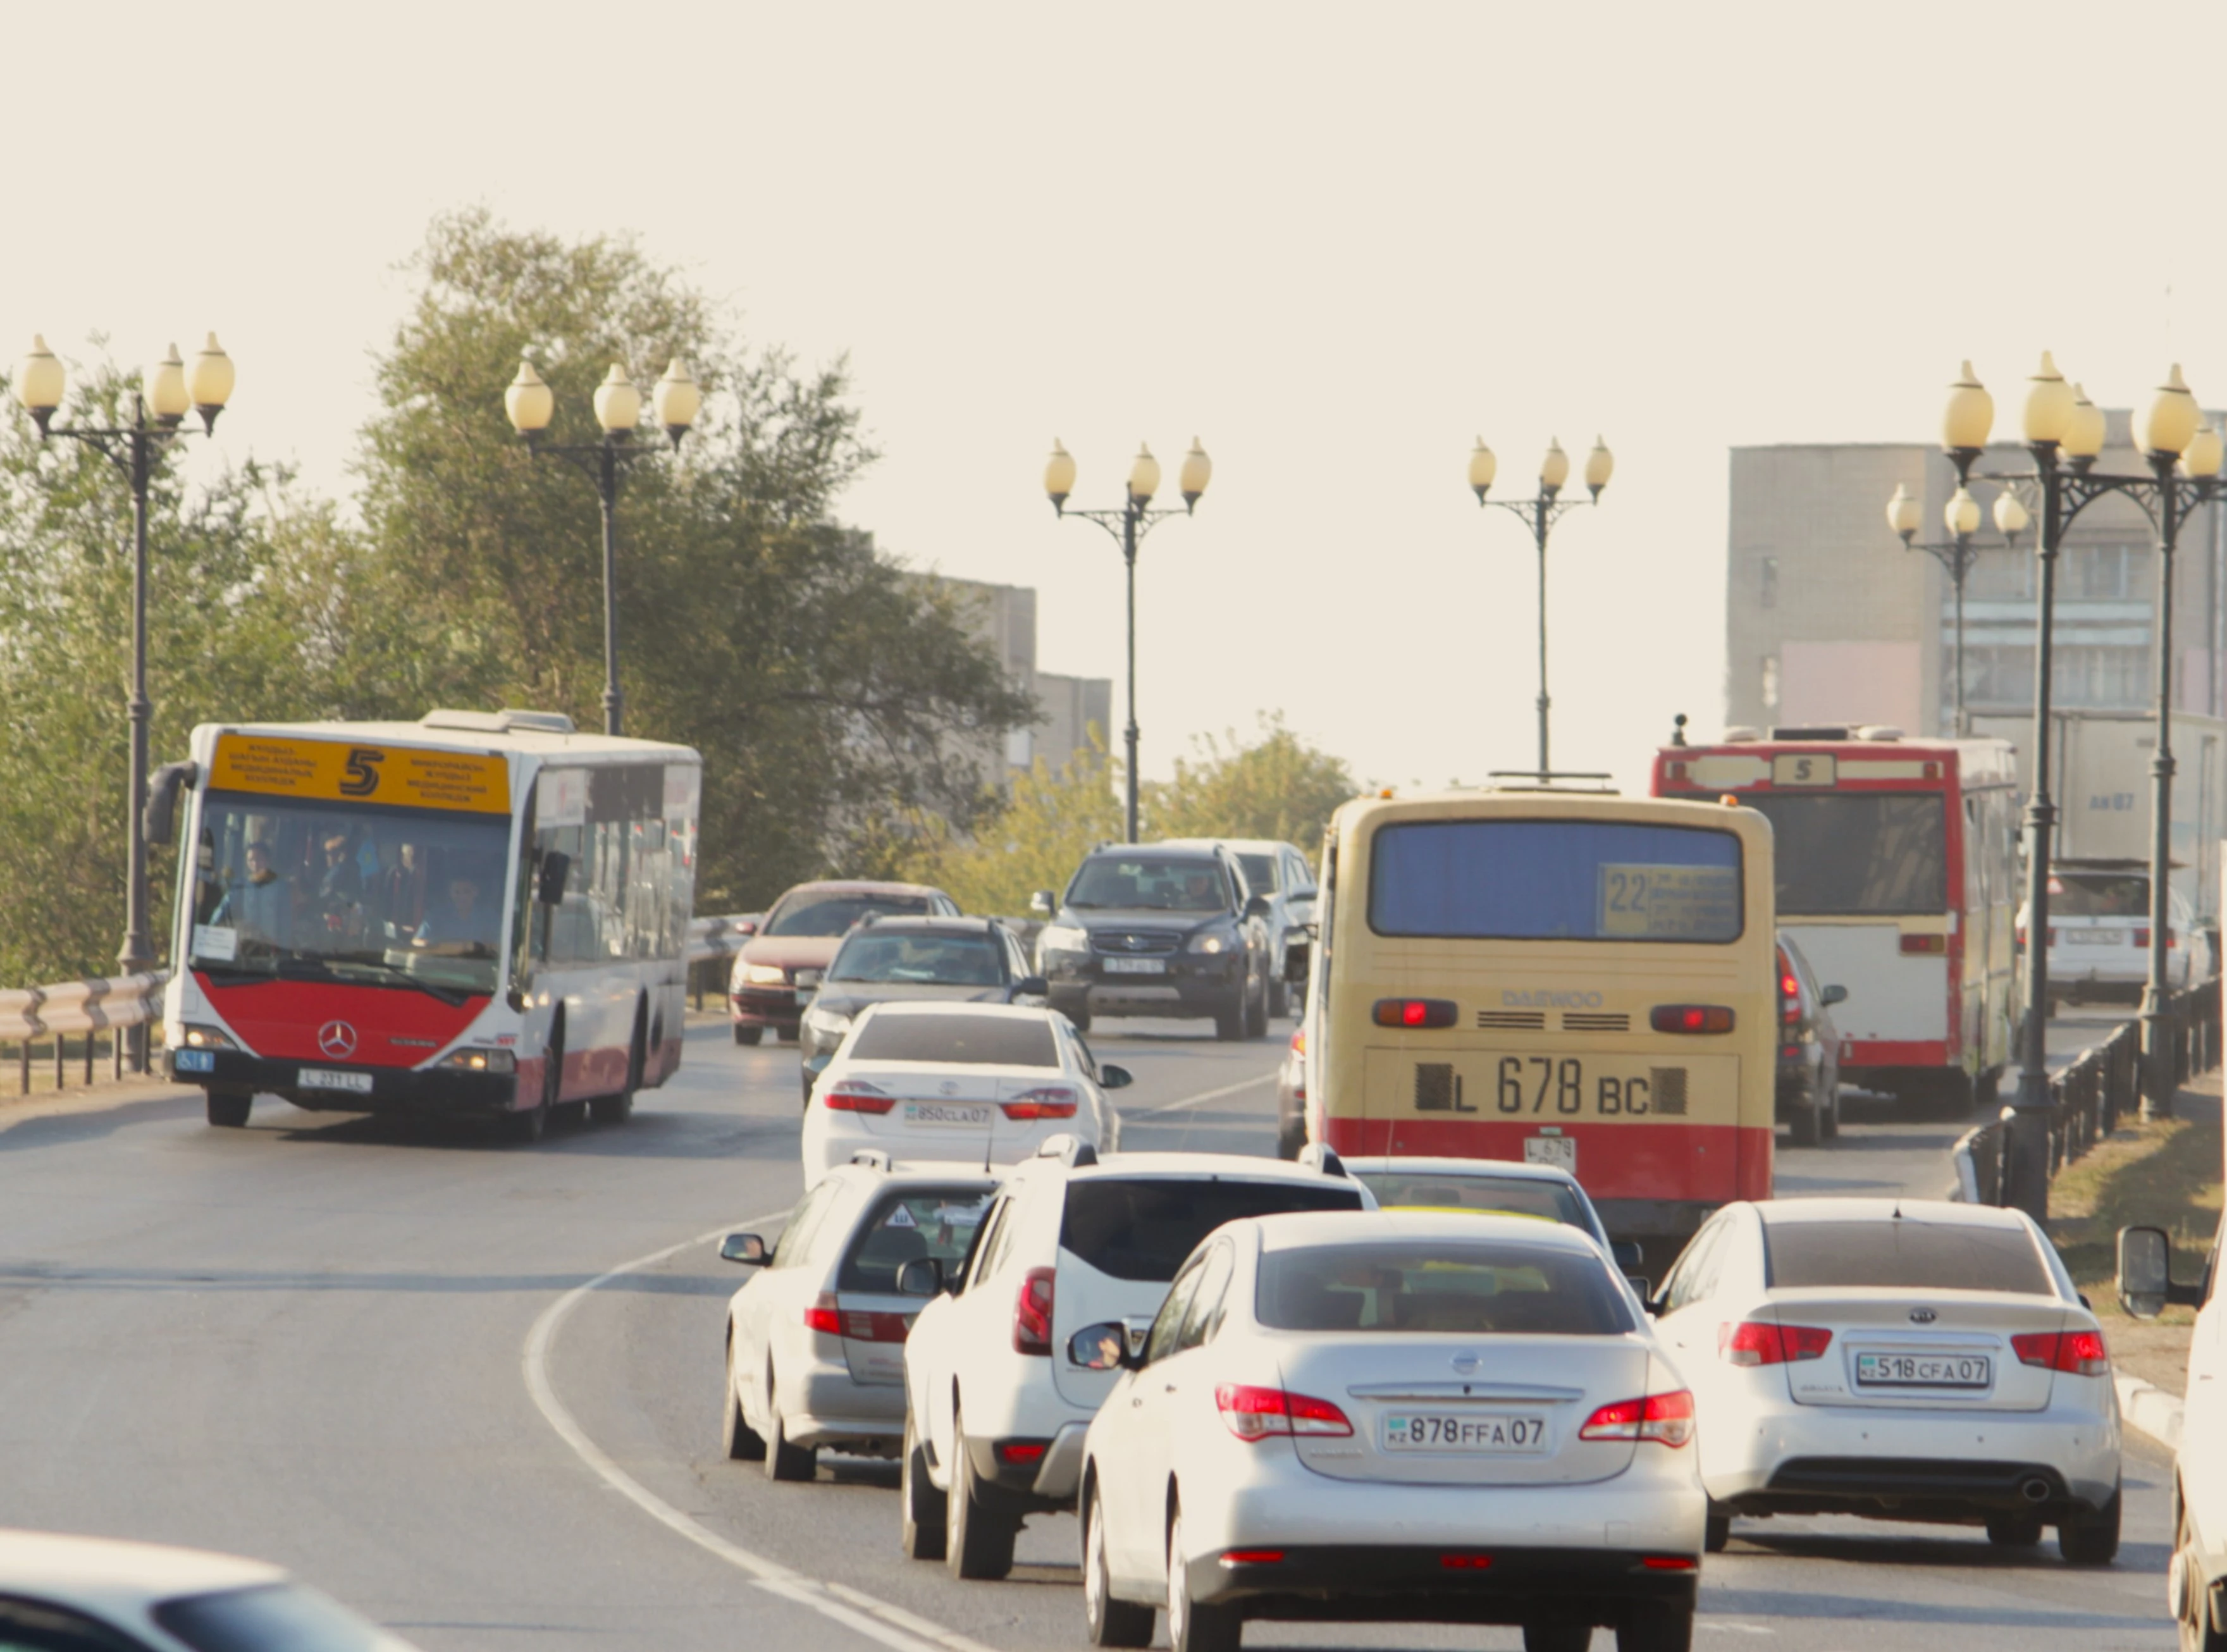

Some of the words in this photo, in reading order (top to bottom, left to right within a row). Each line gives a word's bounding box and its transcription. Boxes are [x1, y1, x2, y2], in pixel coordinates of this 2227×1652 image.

[338, 748, 385, 796] 5
[1794, 759, 1812, 780] 5
[1610, 873, 1646, 911] 22
[1502, 990, 1604, 1008] DAEWOO
[1454, 1075, 1477, 1113] L
[1498, 1057, 1582, 1114] 678
[1598, 1076, 1649, 1114] BC
